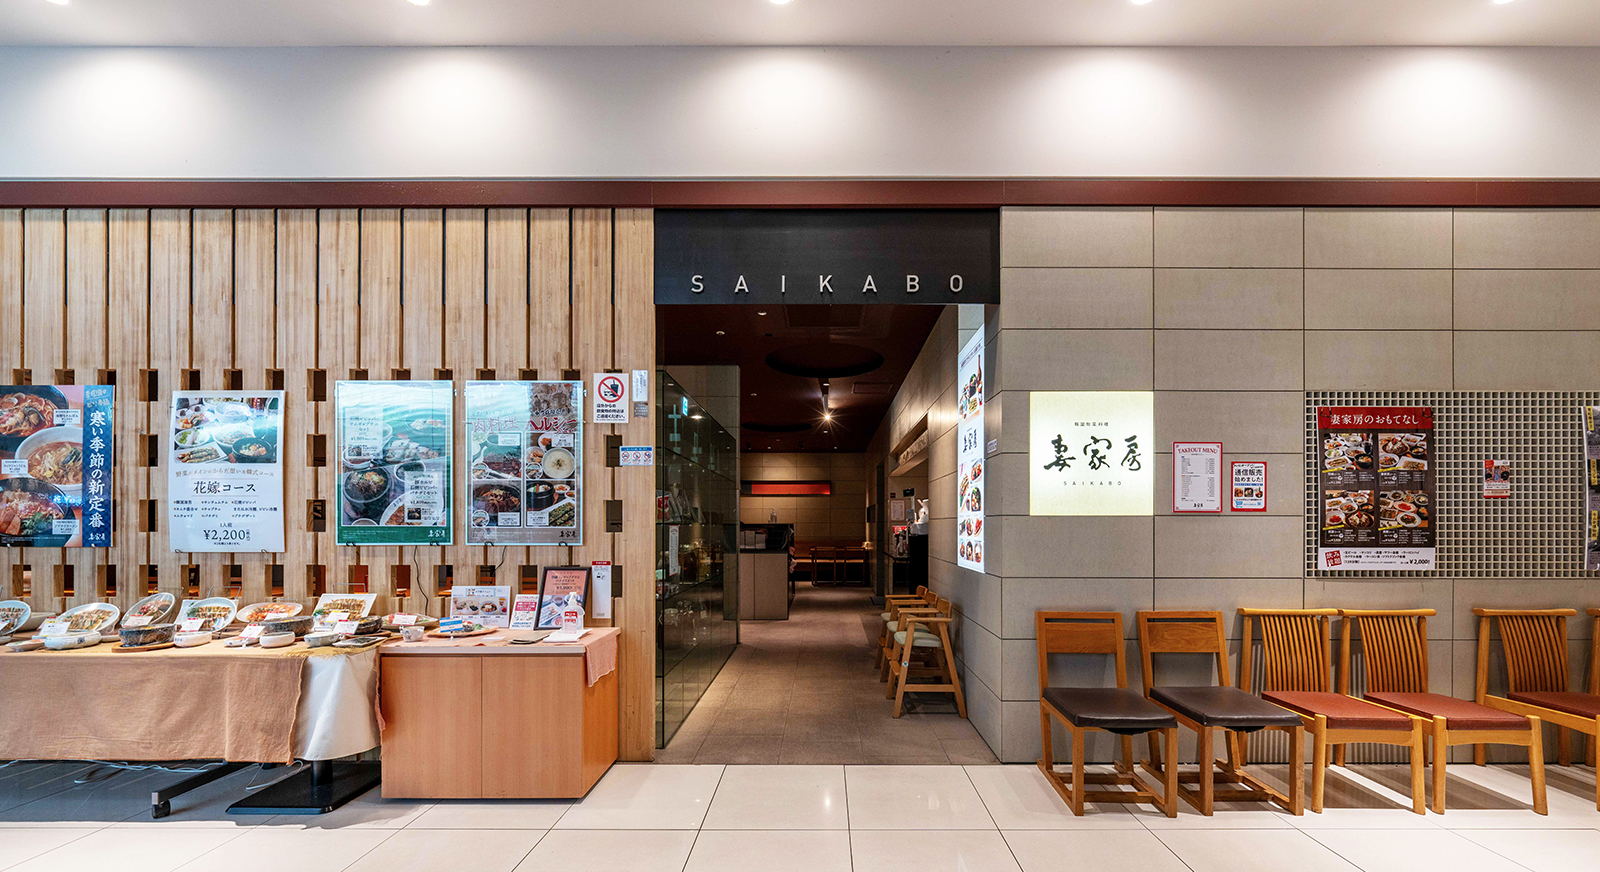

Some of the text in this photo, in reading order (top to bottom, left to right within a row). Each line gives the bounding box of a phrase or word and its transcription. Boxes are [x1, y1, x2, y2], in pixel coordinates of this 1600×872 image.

[691, 274, 963, 293] SAIKABO
[525, 417, 577, 431] ヘルシー
[1330, 414, 1420, 425] 妻家房のおもてなし
[1043, 434, 1142, 472] 妻家房
[88, 410, 106, 528] 寒い季節の新定番
[1234, 468, 1263, 476] 通信販売
[193, 480, 256, 494] 花嫁コース
[203, 529, 246, 542] ¥2,200
